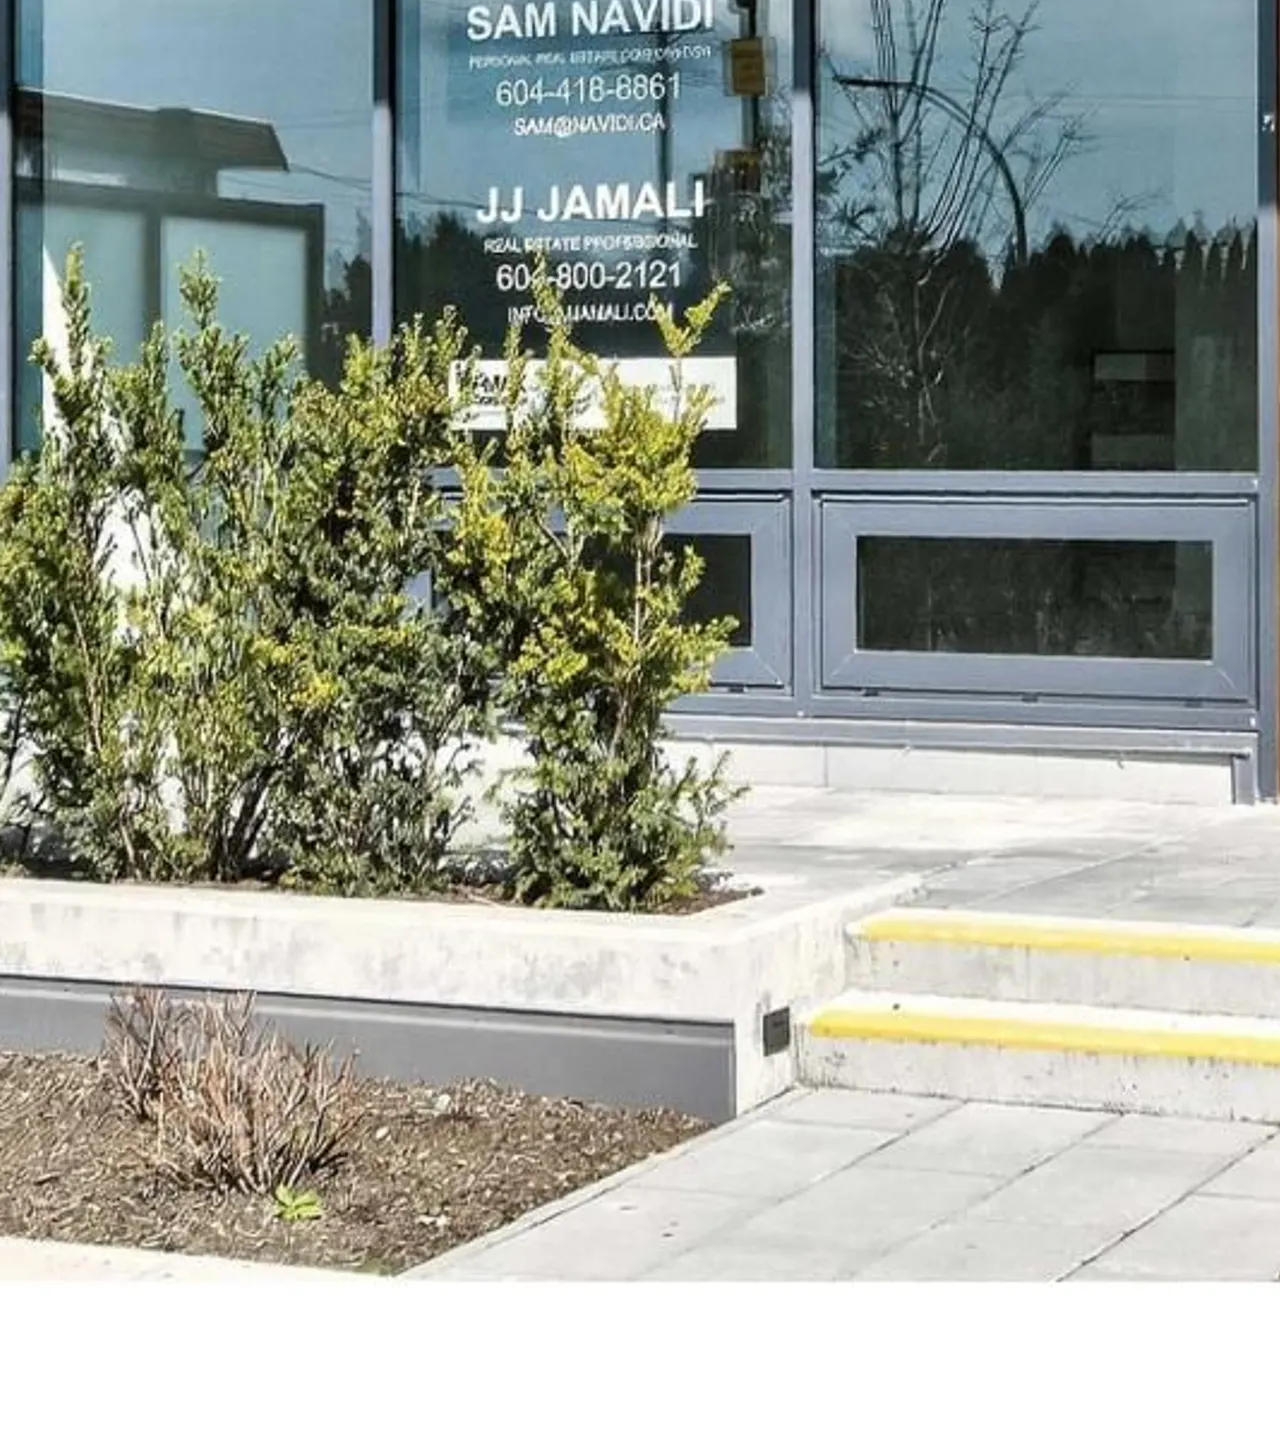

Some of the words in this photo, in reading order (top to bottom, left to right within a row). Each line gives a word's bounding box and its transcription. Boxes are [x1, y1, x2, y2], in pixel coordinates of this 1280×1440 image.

[466, 0, 557, 41] SAM
[495, 71, 681, 107] 604-418-8861
[476, 186, 524, 223] JJ
[536, 179, 705, 221] JAMALI
[495, 259, 681, 291] 60-800-2121
